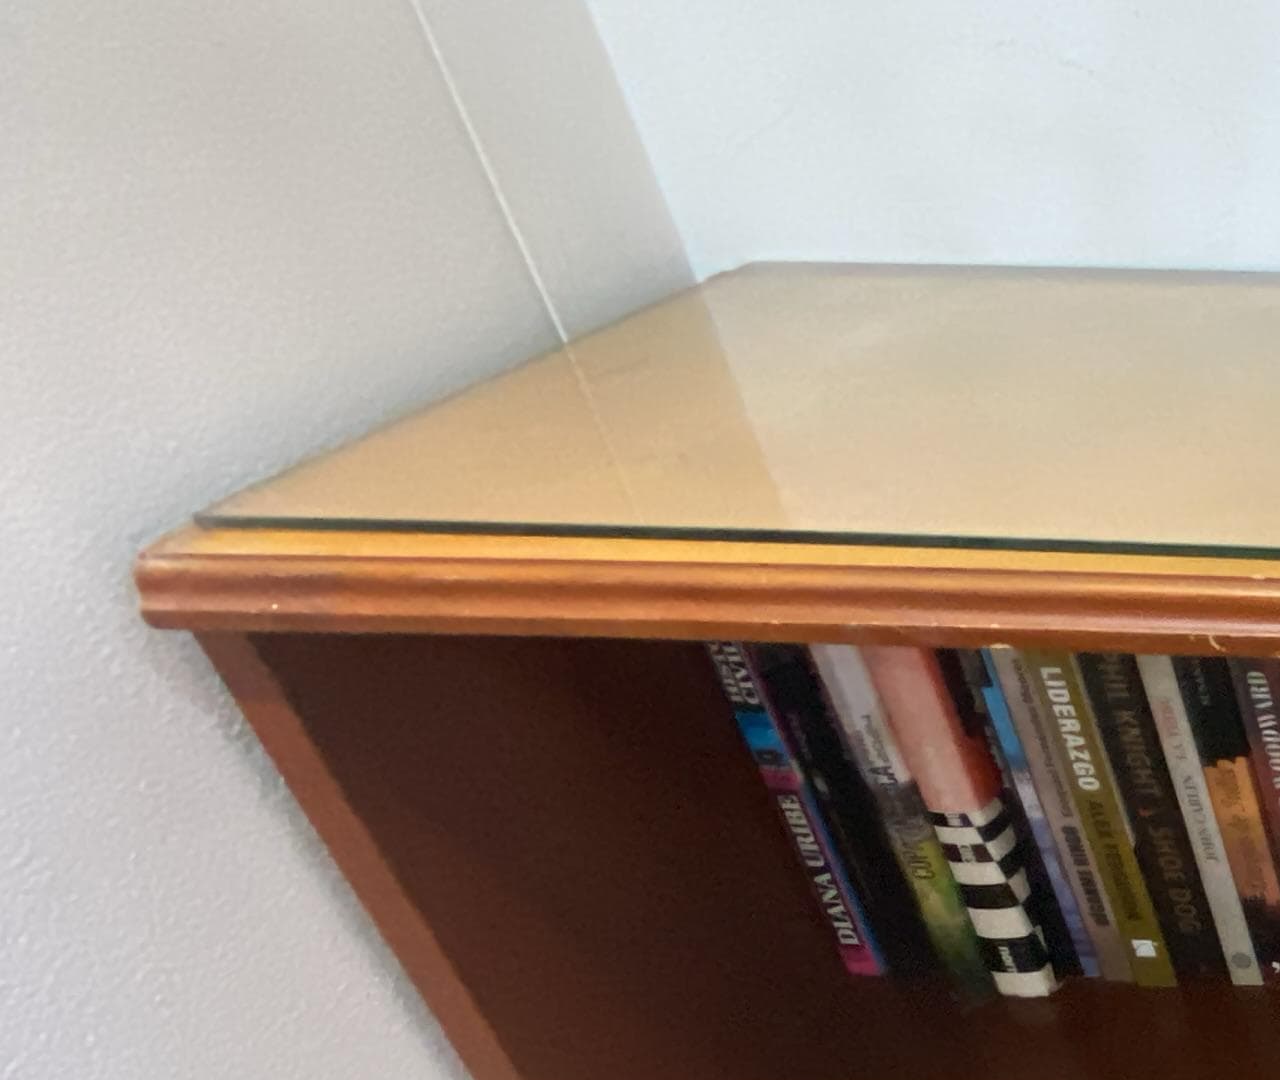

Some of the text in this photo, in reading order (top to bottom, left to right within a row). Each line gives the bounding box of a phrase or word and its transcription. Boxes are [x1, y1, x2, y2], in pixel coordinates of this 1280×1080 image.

[1040, 666, 1101, 792] LIDERAZGO
[776, 793, 861, 947] DIANA URIBE
